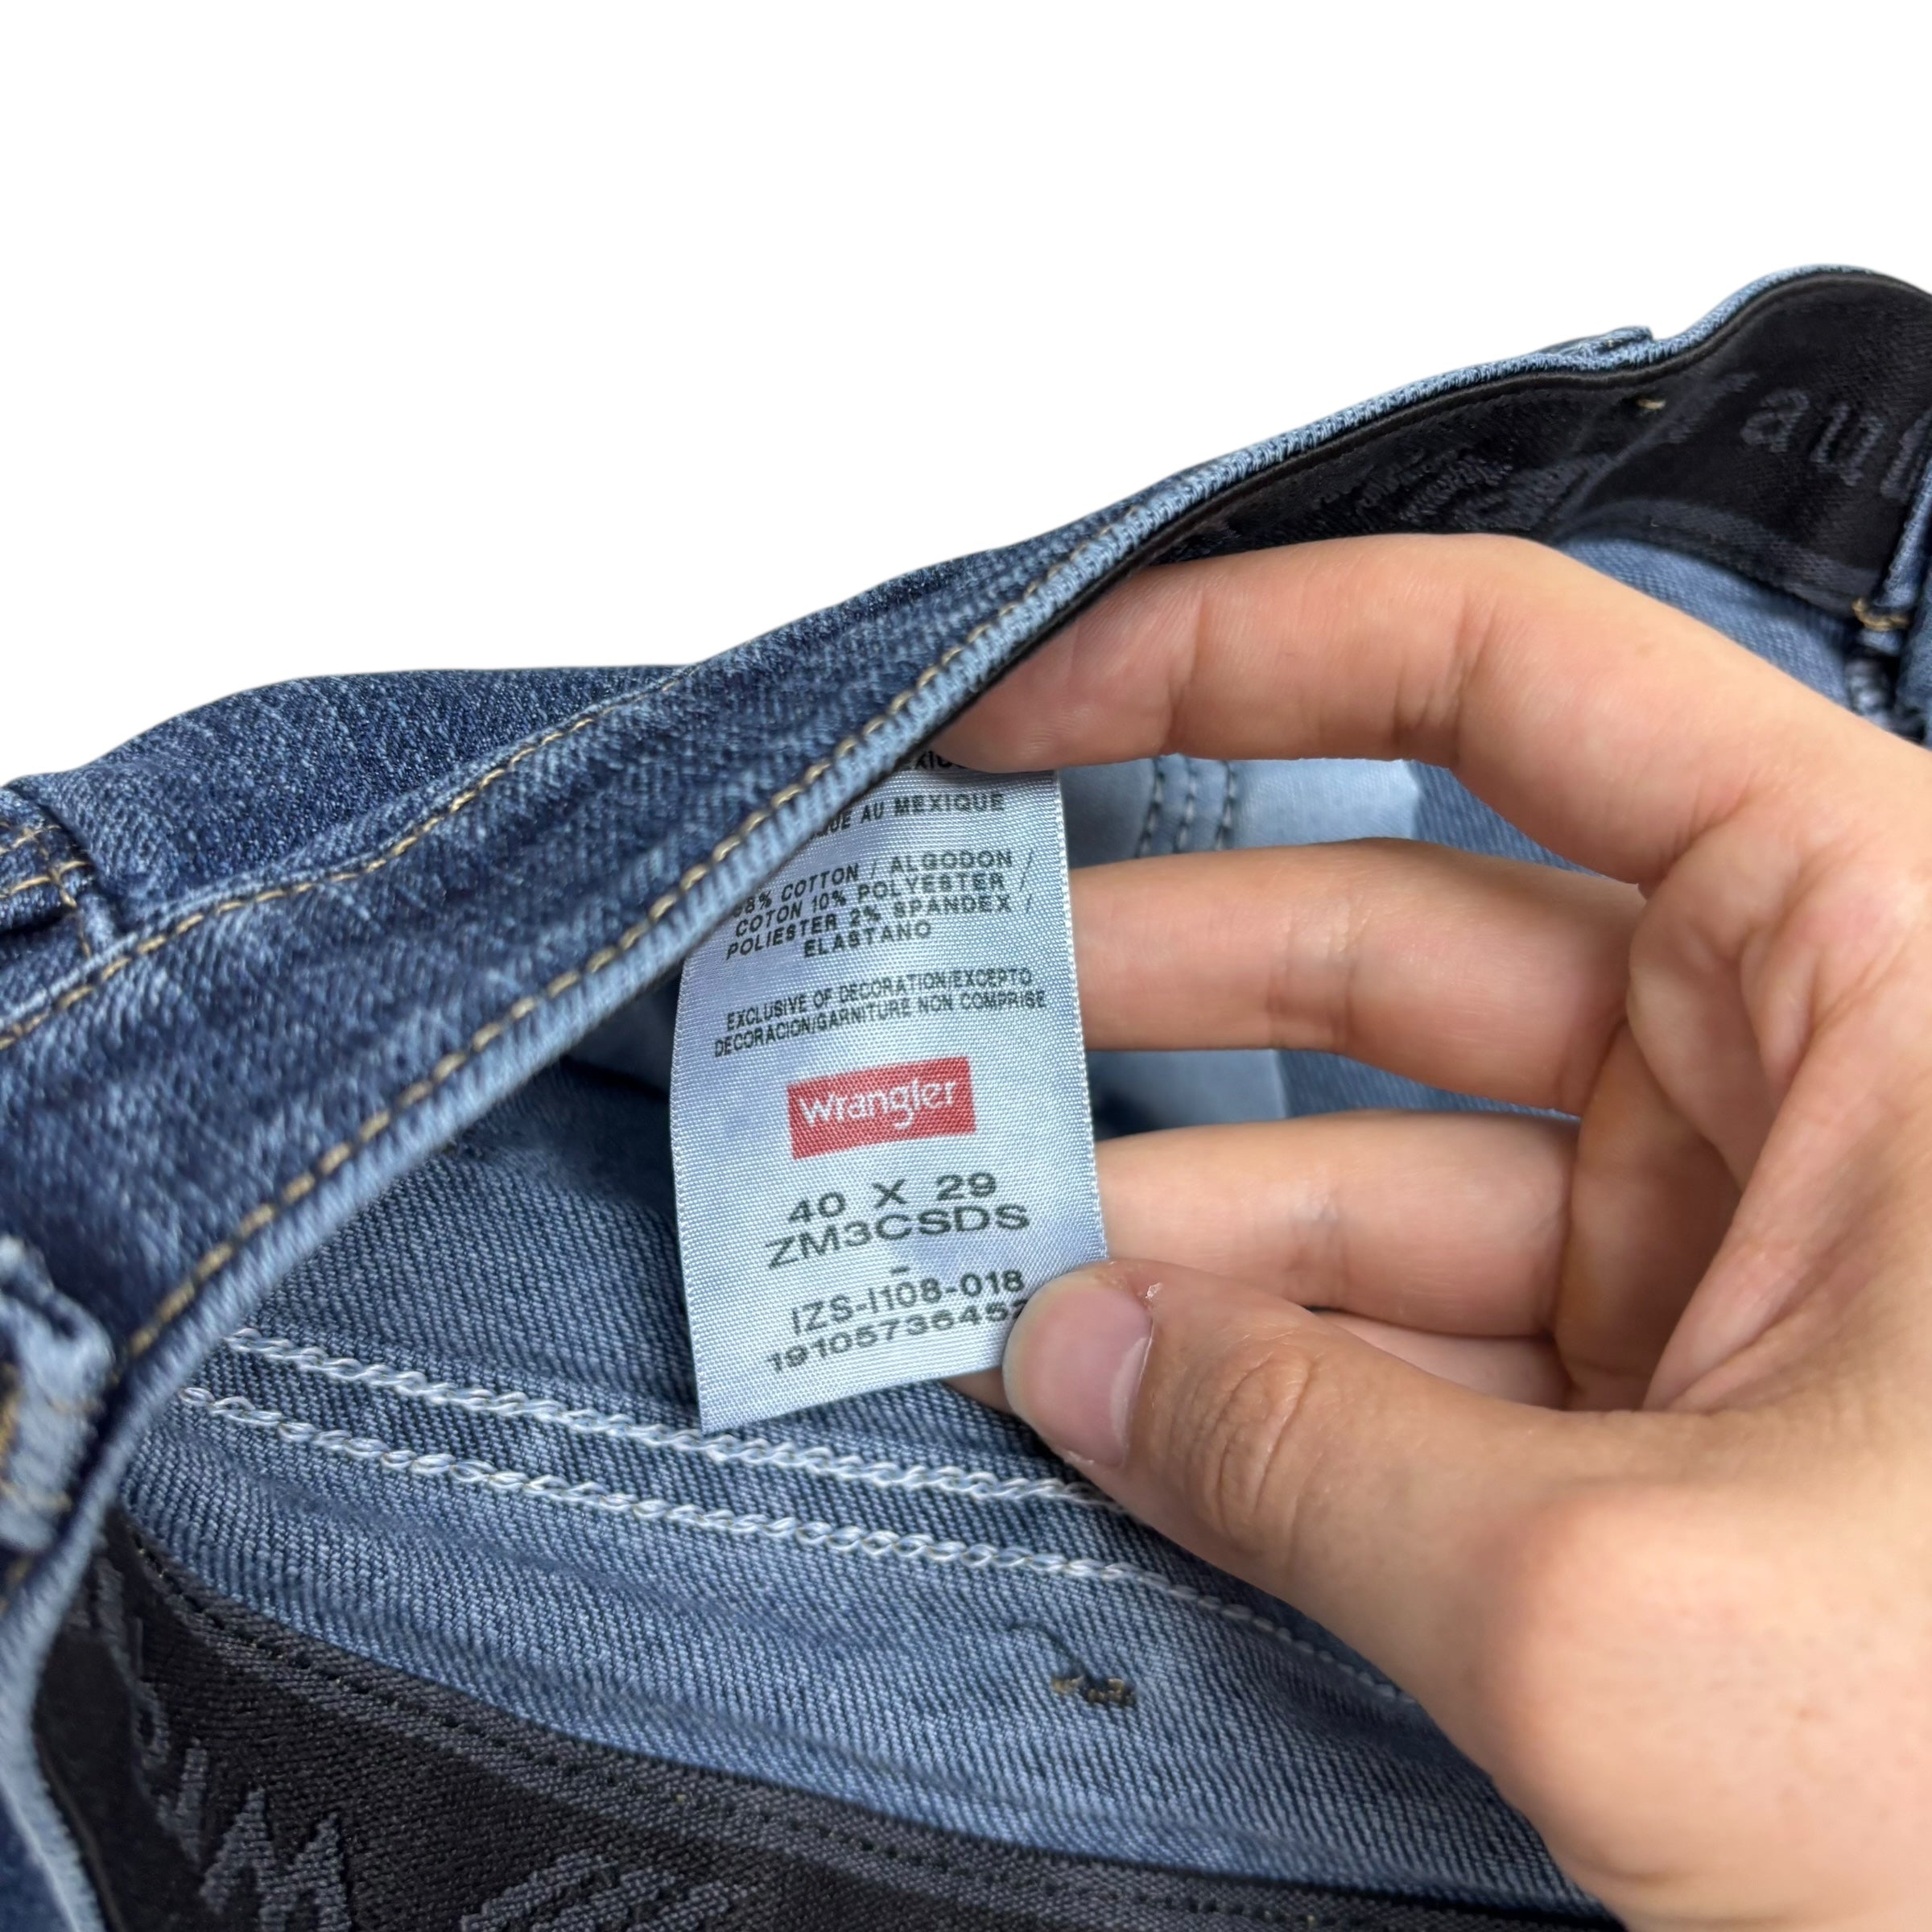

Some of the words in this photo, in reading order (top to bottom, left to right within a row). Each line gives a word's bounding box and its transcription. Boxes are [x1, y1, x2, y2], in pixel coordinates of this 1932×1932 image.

[861, 801, 884, 824] AU
[894, 793, 1005, 816] MEXIQUE
[781, 862, 859, 902] COTTON
[891, 848, 1013, 873] ALGODON
[726, 914, 838, 960] POLIESTER
[849, 904, 882, 926] 2%
[894, 894, 1012, 919] SPANDEX
[736, 902, 803, 938] COTON
[811, 890, 847, 913] 10%
[858, 872, 1005, 900] POLYESTER
[804, 921, 931, 958] ELASTANO
[727, 994, 807, 1031] EXCLUSIVE
[813, 988, 833, 1009] OF
[919, 994, 954, 1013] NON
[960, 989, 1045, 1010] COMPRISE
[798, 1076, 957, 1129] Wrangler
[788, 1191, 847, 1224] 40
[935, 1172, 997, 1201] 29
[765, 1204, 1030, 1269] ZM3CSDS
